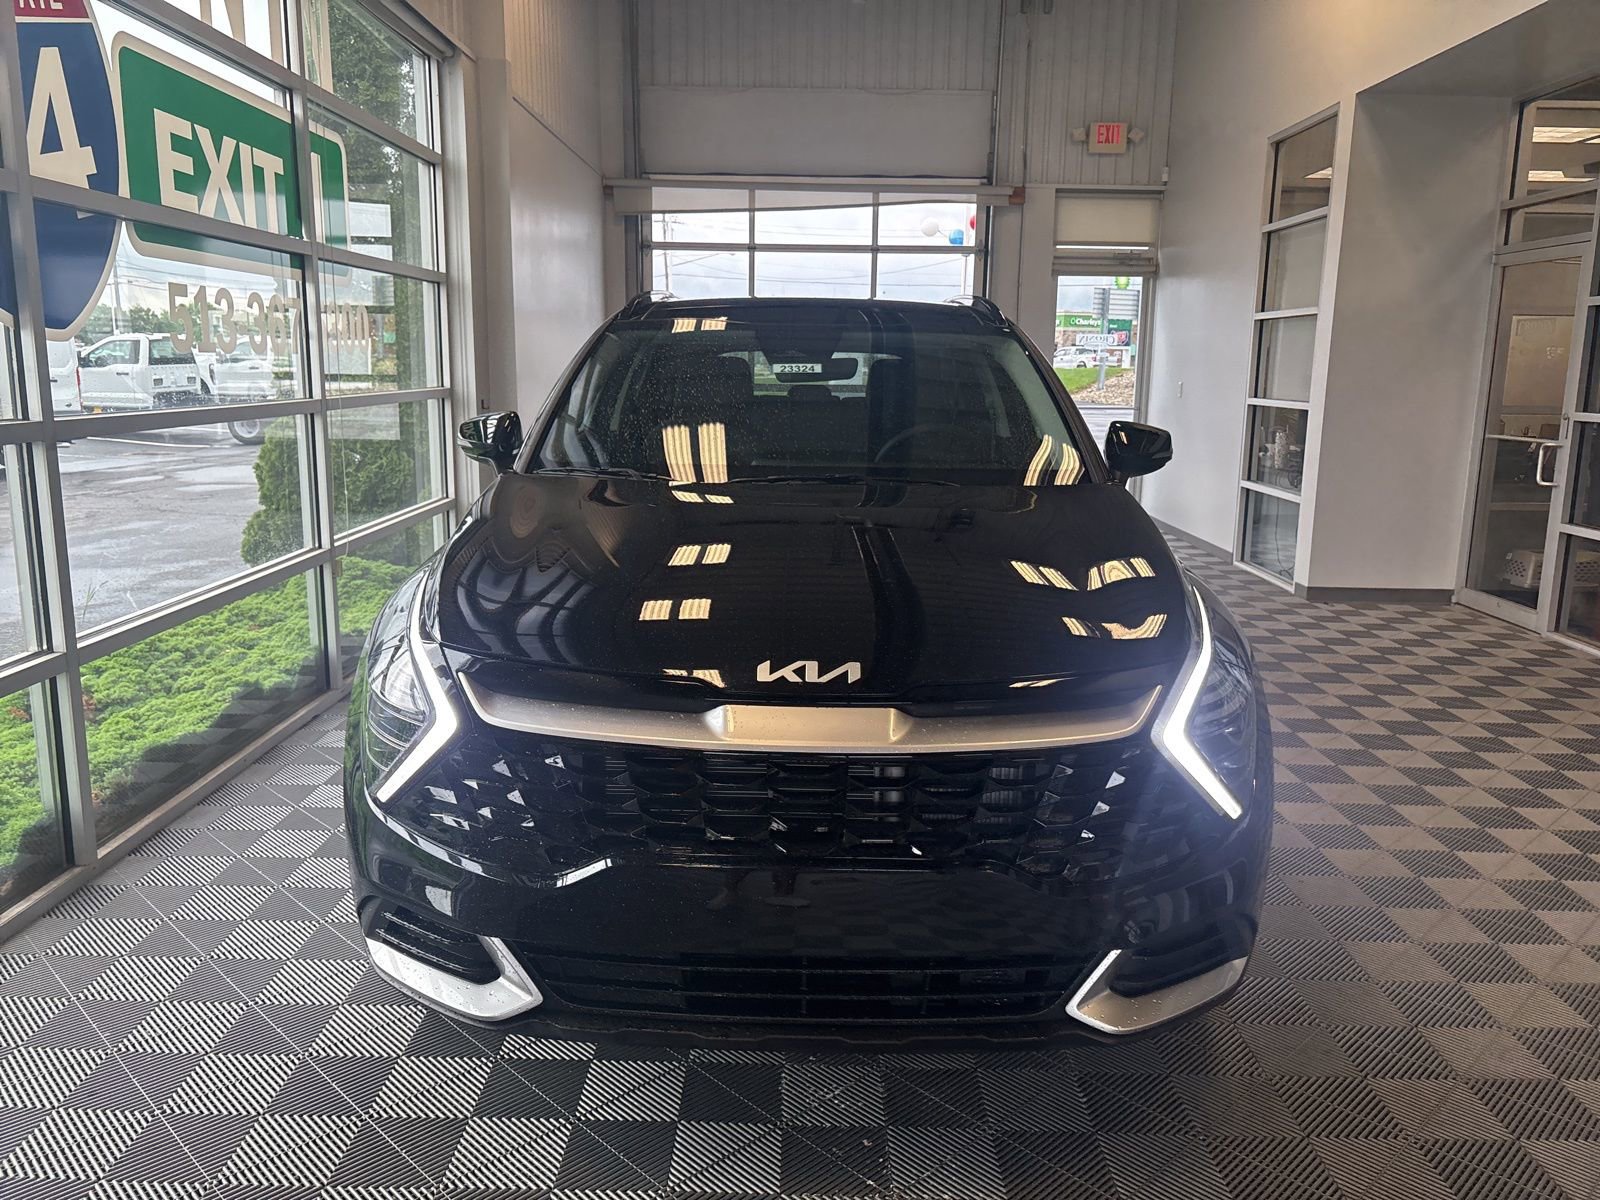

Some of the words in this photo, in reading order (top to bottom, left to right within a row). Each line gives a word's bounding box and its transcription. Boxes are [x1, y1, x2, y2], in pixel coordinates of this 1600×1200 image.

[1097, 124, 1121, 144] EXIT
[153, 108, 285, 235] EXIT
[780, 365, 815, 373] 23324
